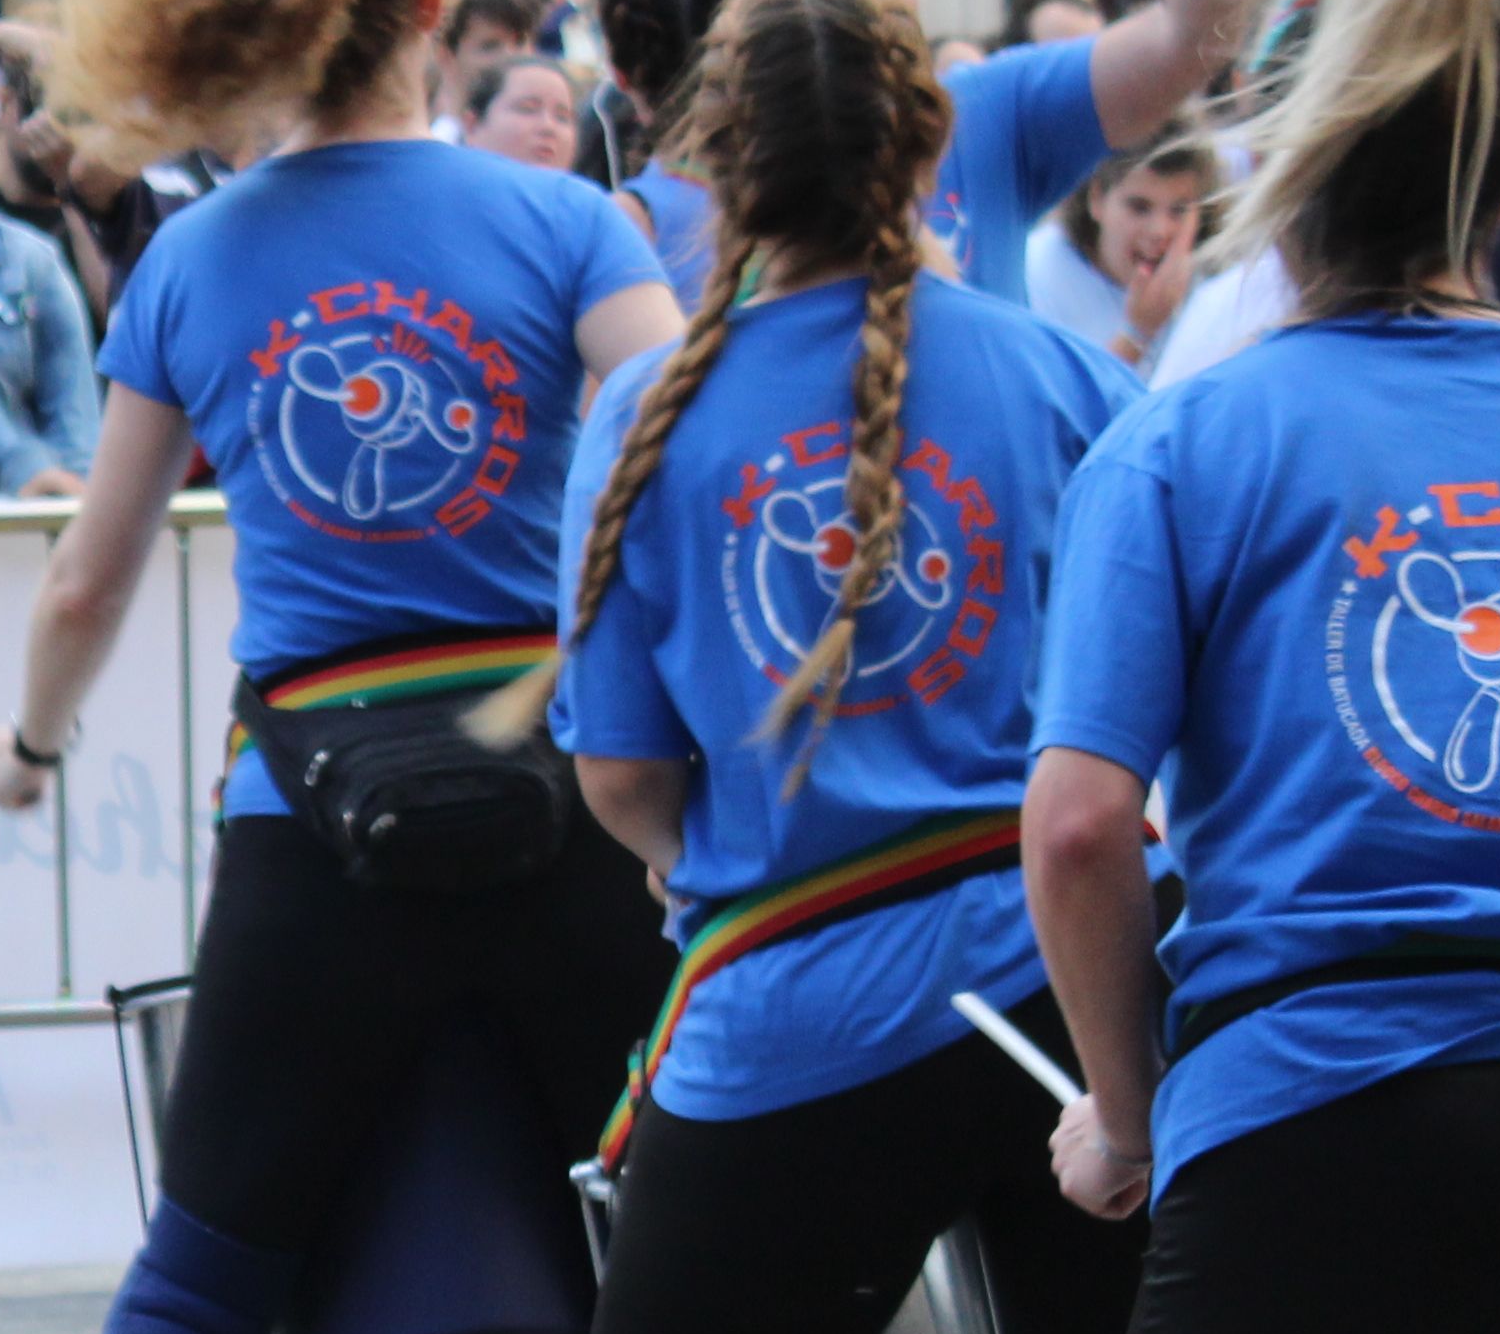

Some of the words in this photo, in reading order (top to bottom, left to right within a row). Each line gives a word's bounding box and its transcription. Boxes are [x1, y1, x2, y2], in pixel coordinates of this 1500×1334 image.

[1325, 598, 1352, 650] TALLER
[1325, 653, 1345, 674] DE
[1327, 674, 1371, 752] BATUCADA
